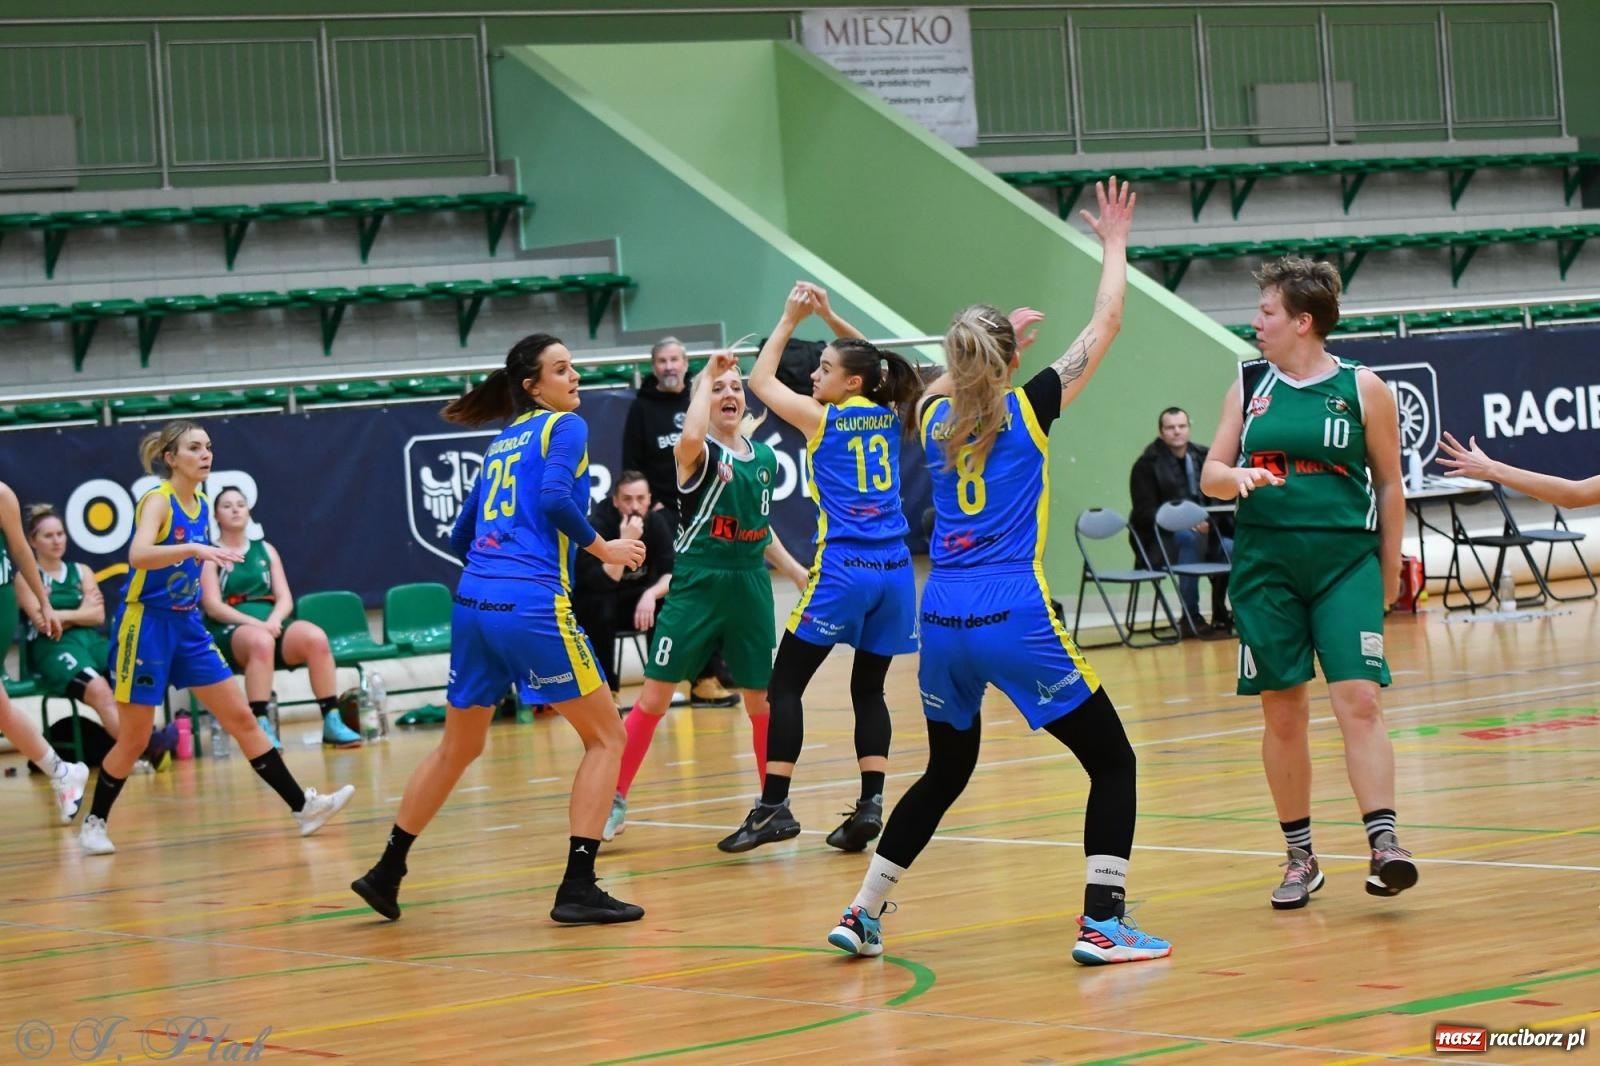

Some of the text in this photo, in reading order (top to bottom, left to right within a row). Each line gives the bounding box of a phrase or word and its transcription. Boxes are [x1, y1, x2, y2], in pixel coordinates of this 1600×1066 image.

[824, 15, 952, 46] MIESZKO
[1323, 416, 1350, 449] 10
[847, 434, 892, 493] 13
[484, 452, 521, 521] 25
[956, 444, 987, 516] 8
[760, 488, 770, 516] 8
[713, 515, 733, 539] K
[479, 599, 516, 612] decor
[923, 609, 1010, 629] schatt decor
[58, 652, 78, 671] 3
[655, 636, 673, 667] 8
[1237, 643, 1258, 680] 10
